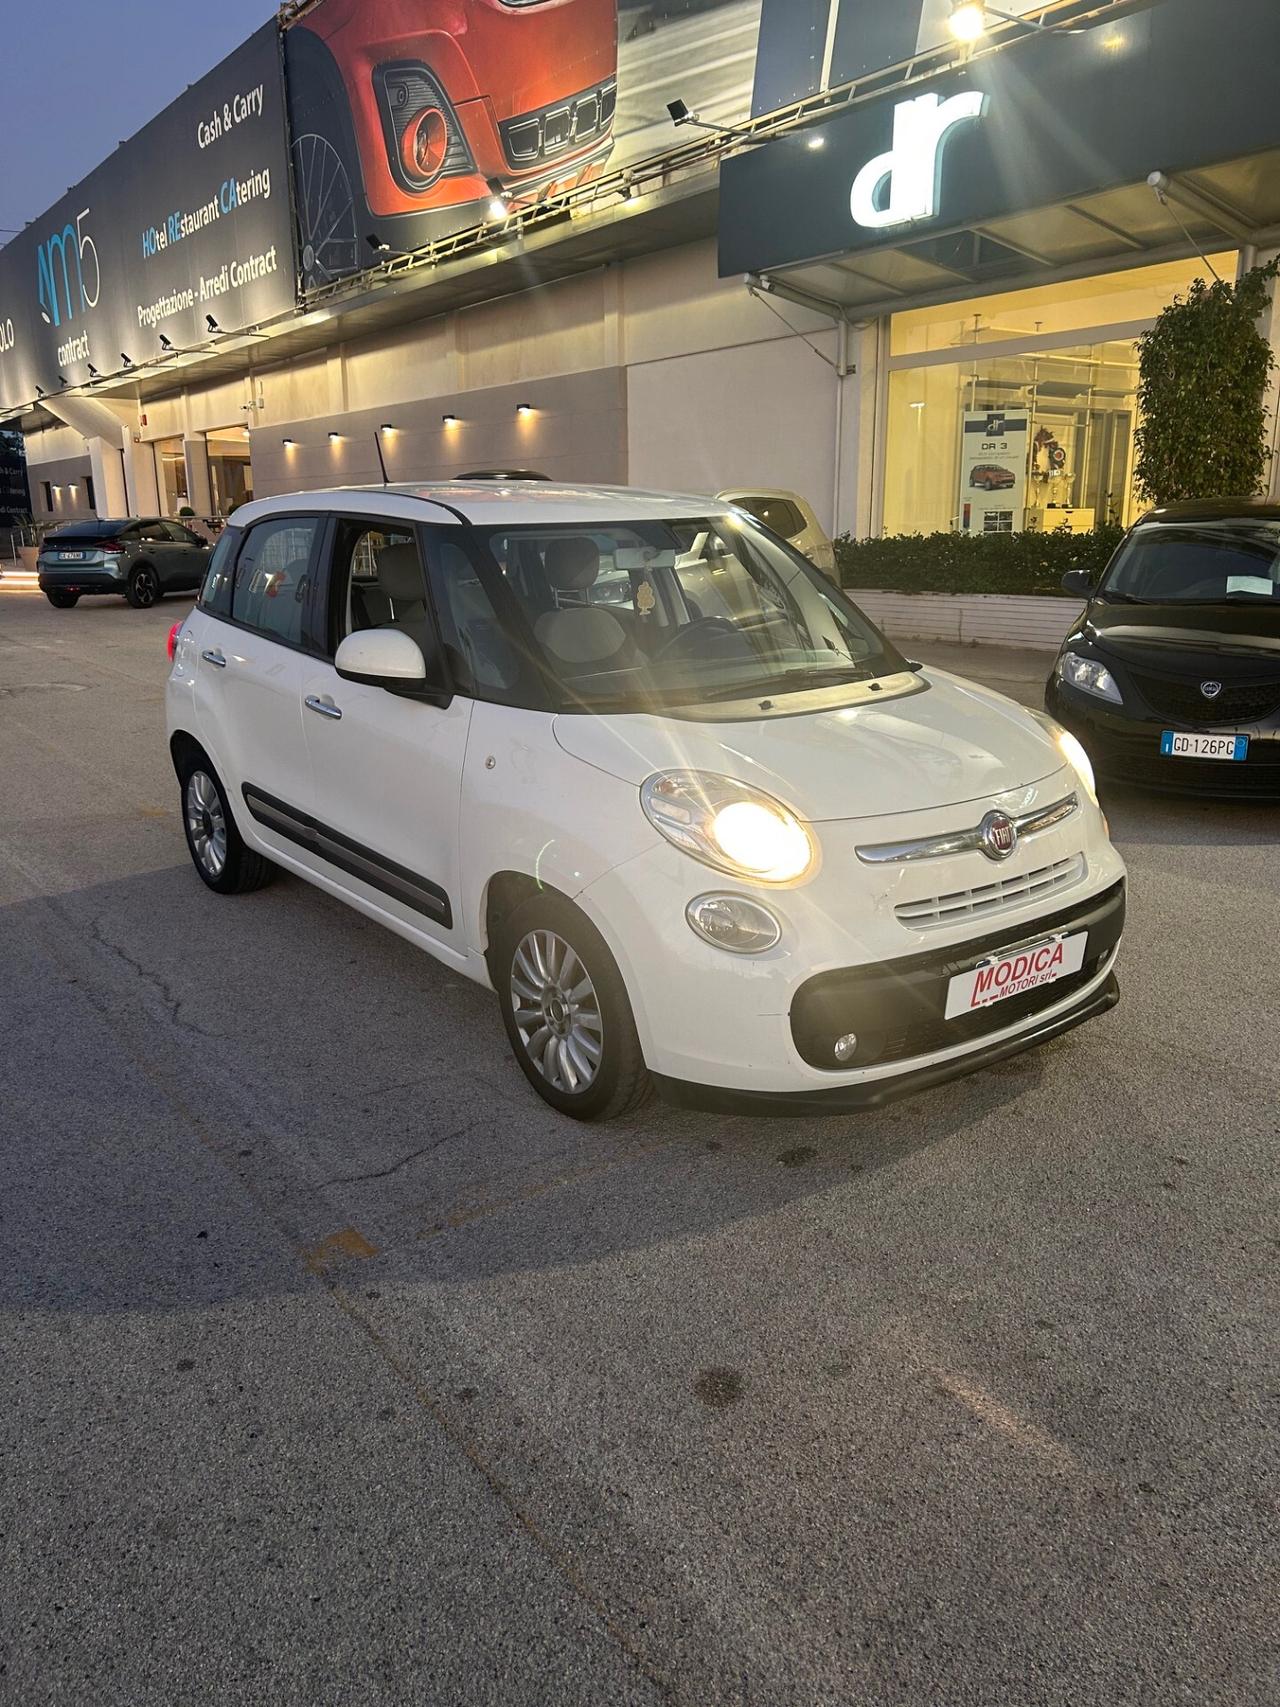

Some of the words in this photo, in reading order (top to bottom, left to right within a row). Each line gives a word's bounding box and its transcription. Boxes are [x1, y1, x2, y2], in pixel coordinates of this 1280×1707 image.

[197, 110, 222, 149] Cash
[223, 103, 232, 132] &
[233, 84, 264, 123] Carry
[142, 222, 168, 258] HOtel
[167, 195, 220, 245] REstaurant
[220, 168, 271, 215] CAtering
[137, 288, 194, 328] Progettazione
[199, 265, 229, 302] Arredi
[230, 245, 278, 288] Contract
[57, 330, 90, 367] contract
[1000, 442, 1008, 450] 3
[994, 826, 1011, 846] FIAT
[970, 943, 1063, 1006] MODICA
[999, 973, 1038, 998] MOTORI
